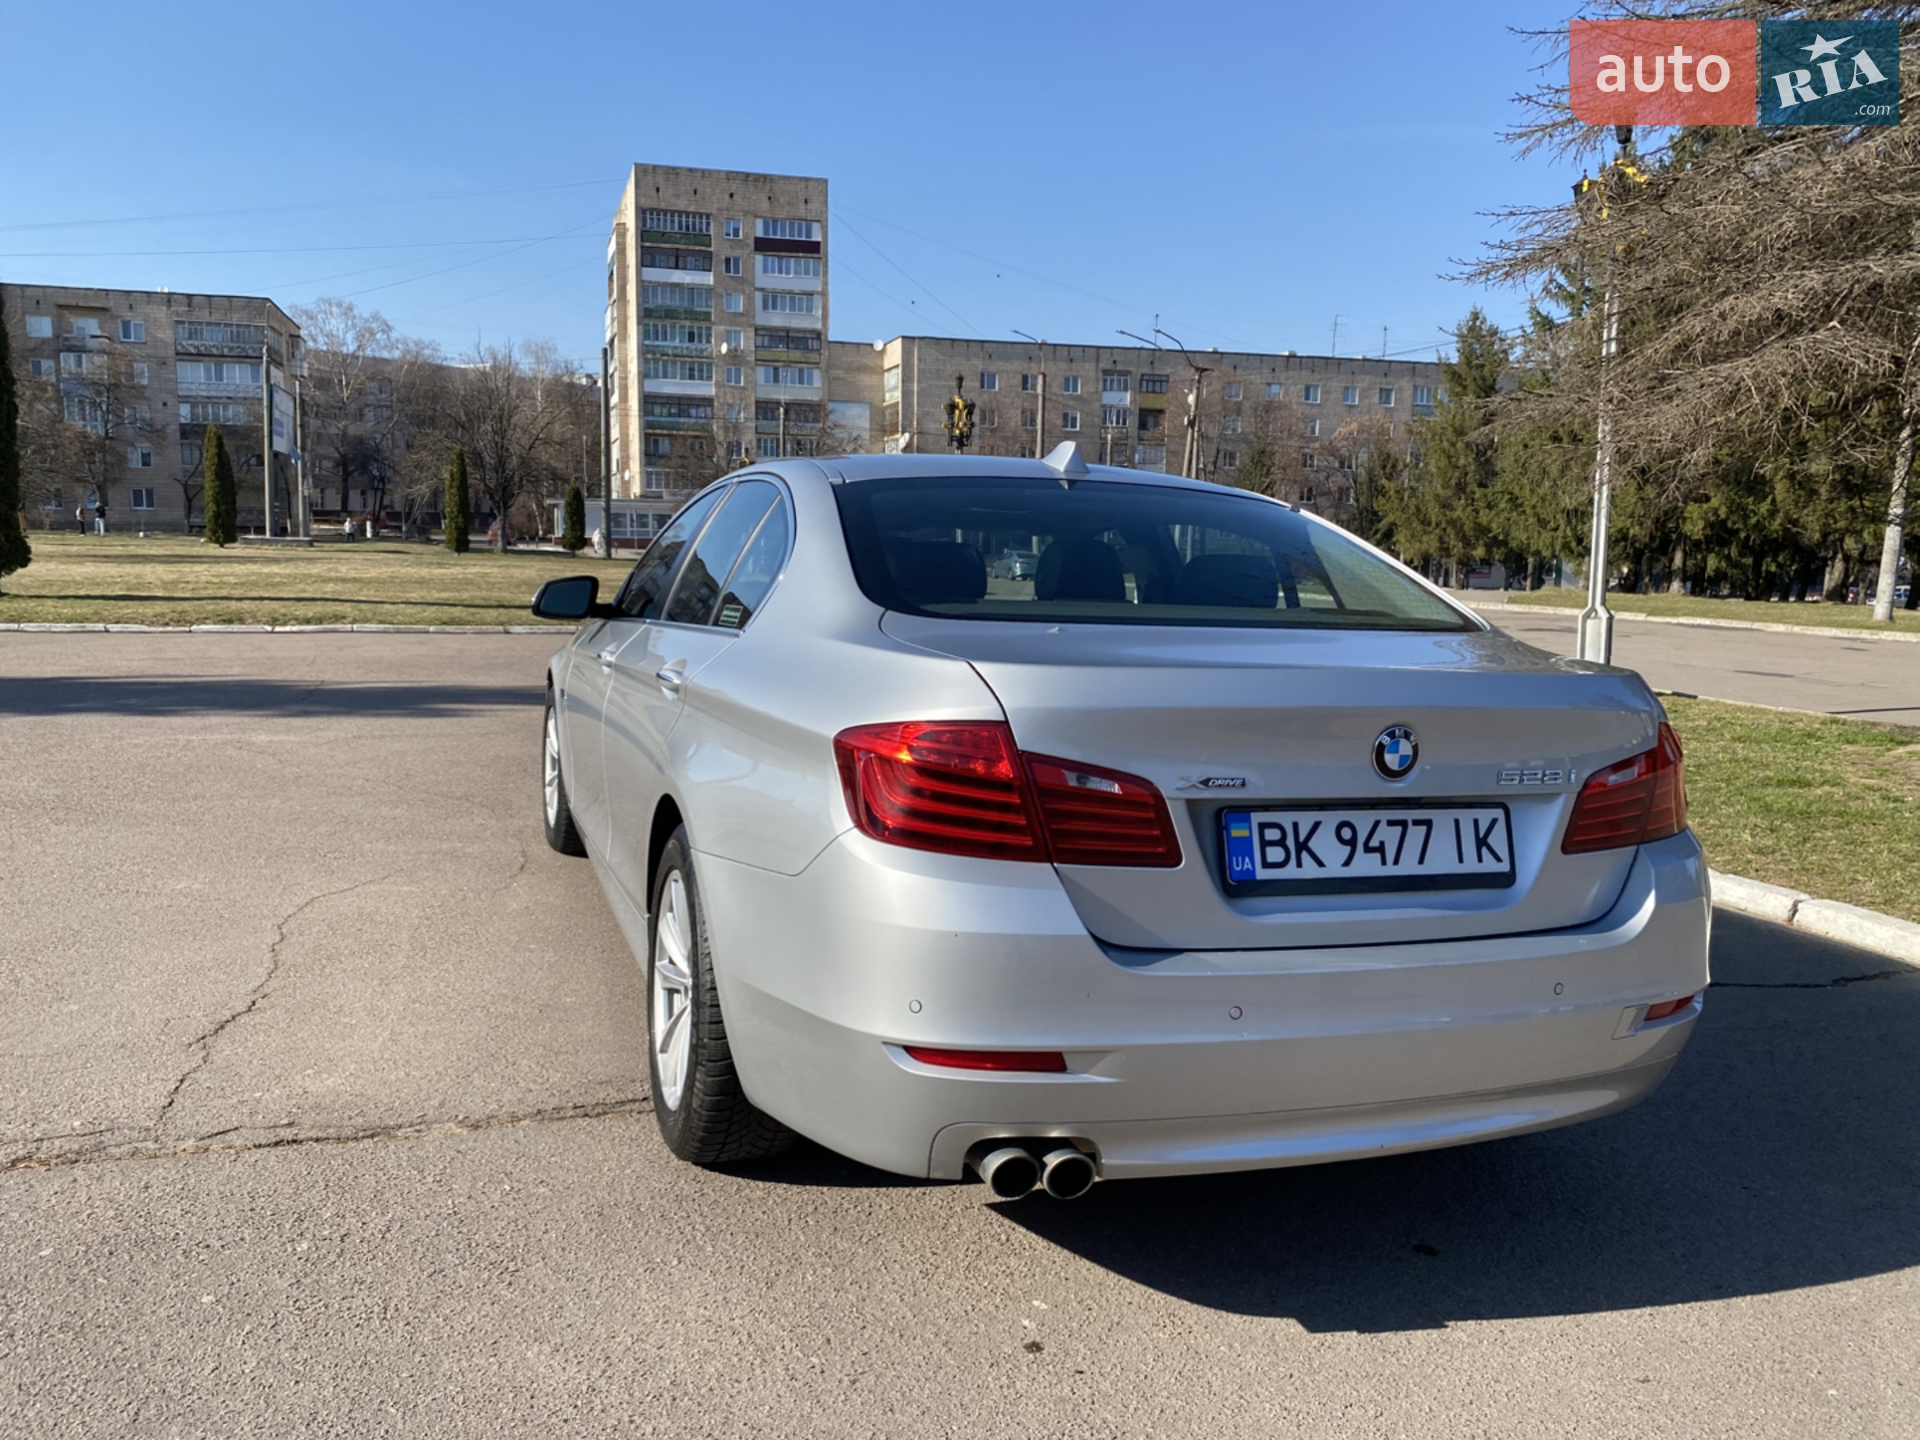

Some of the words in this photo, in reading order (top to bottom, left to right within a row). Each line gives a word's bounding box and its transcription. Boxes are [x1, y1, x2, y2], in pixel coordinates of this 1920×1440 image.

[1257, 821, 1327, 869] BK
[1335, 819, 1433, 867] 9477
[1454, 818, 1503, 864] IK
[1232, 856, 1253, 871] UA
